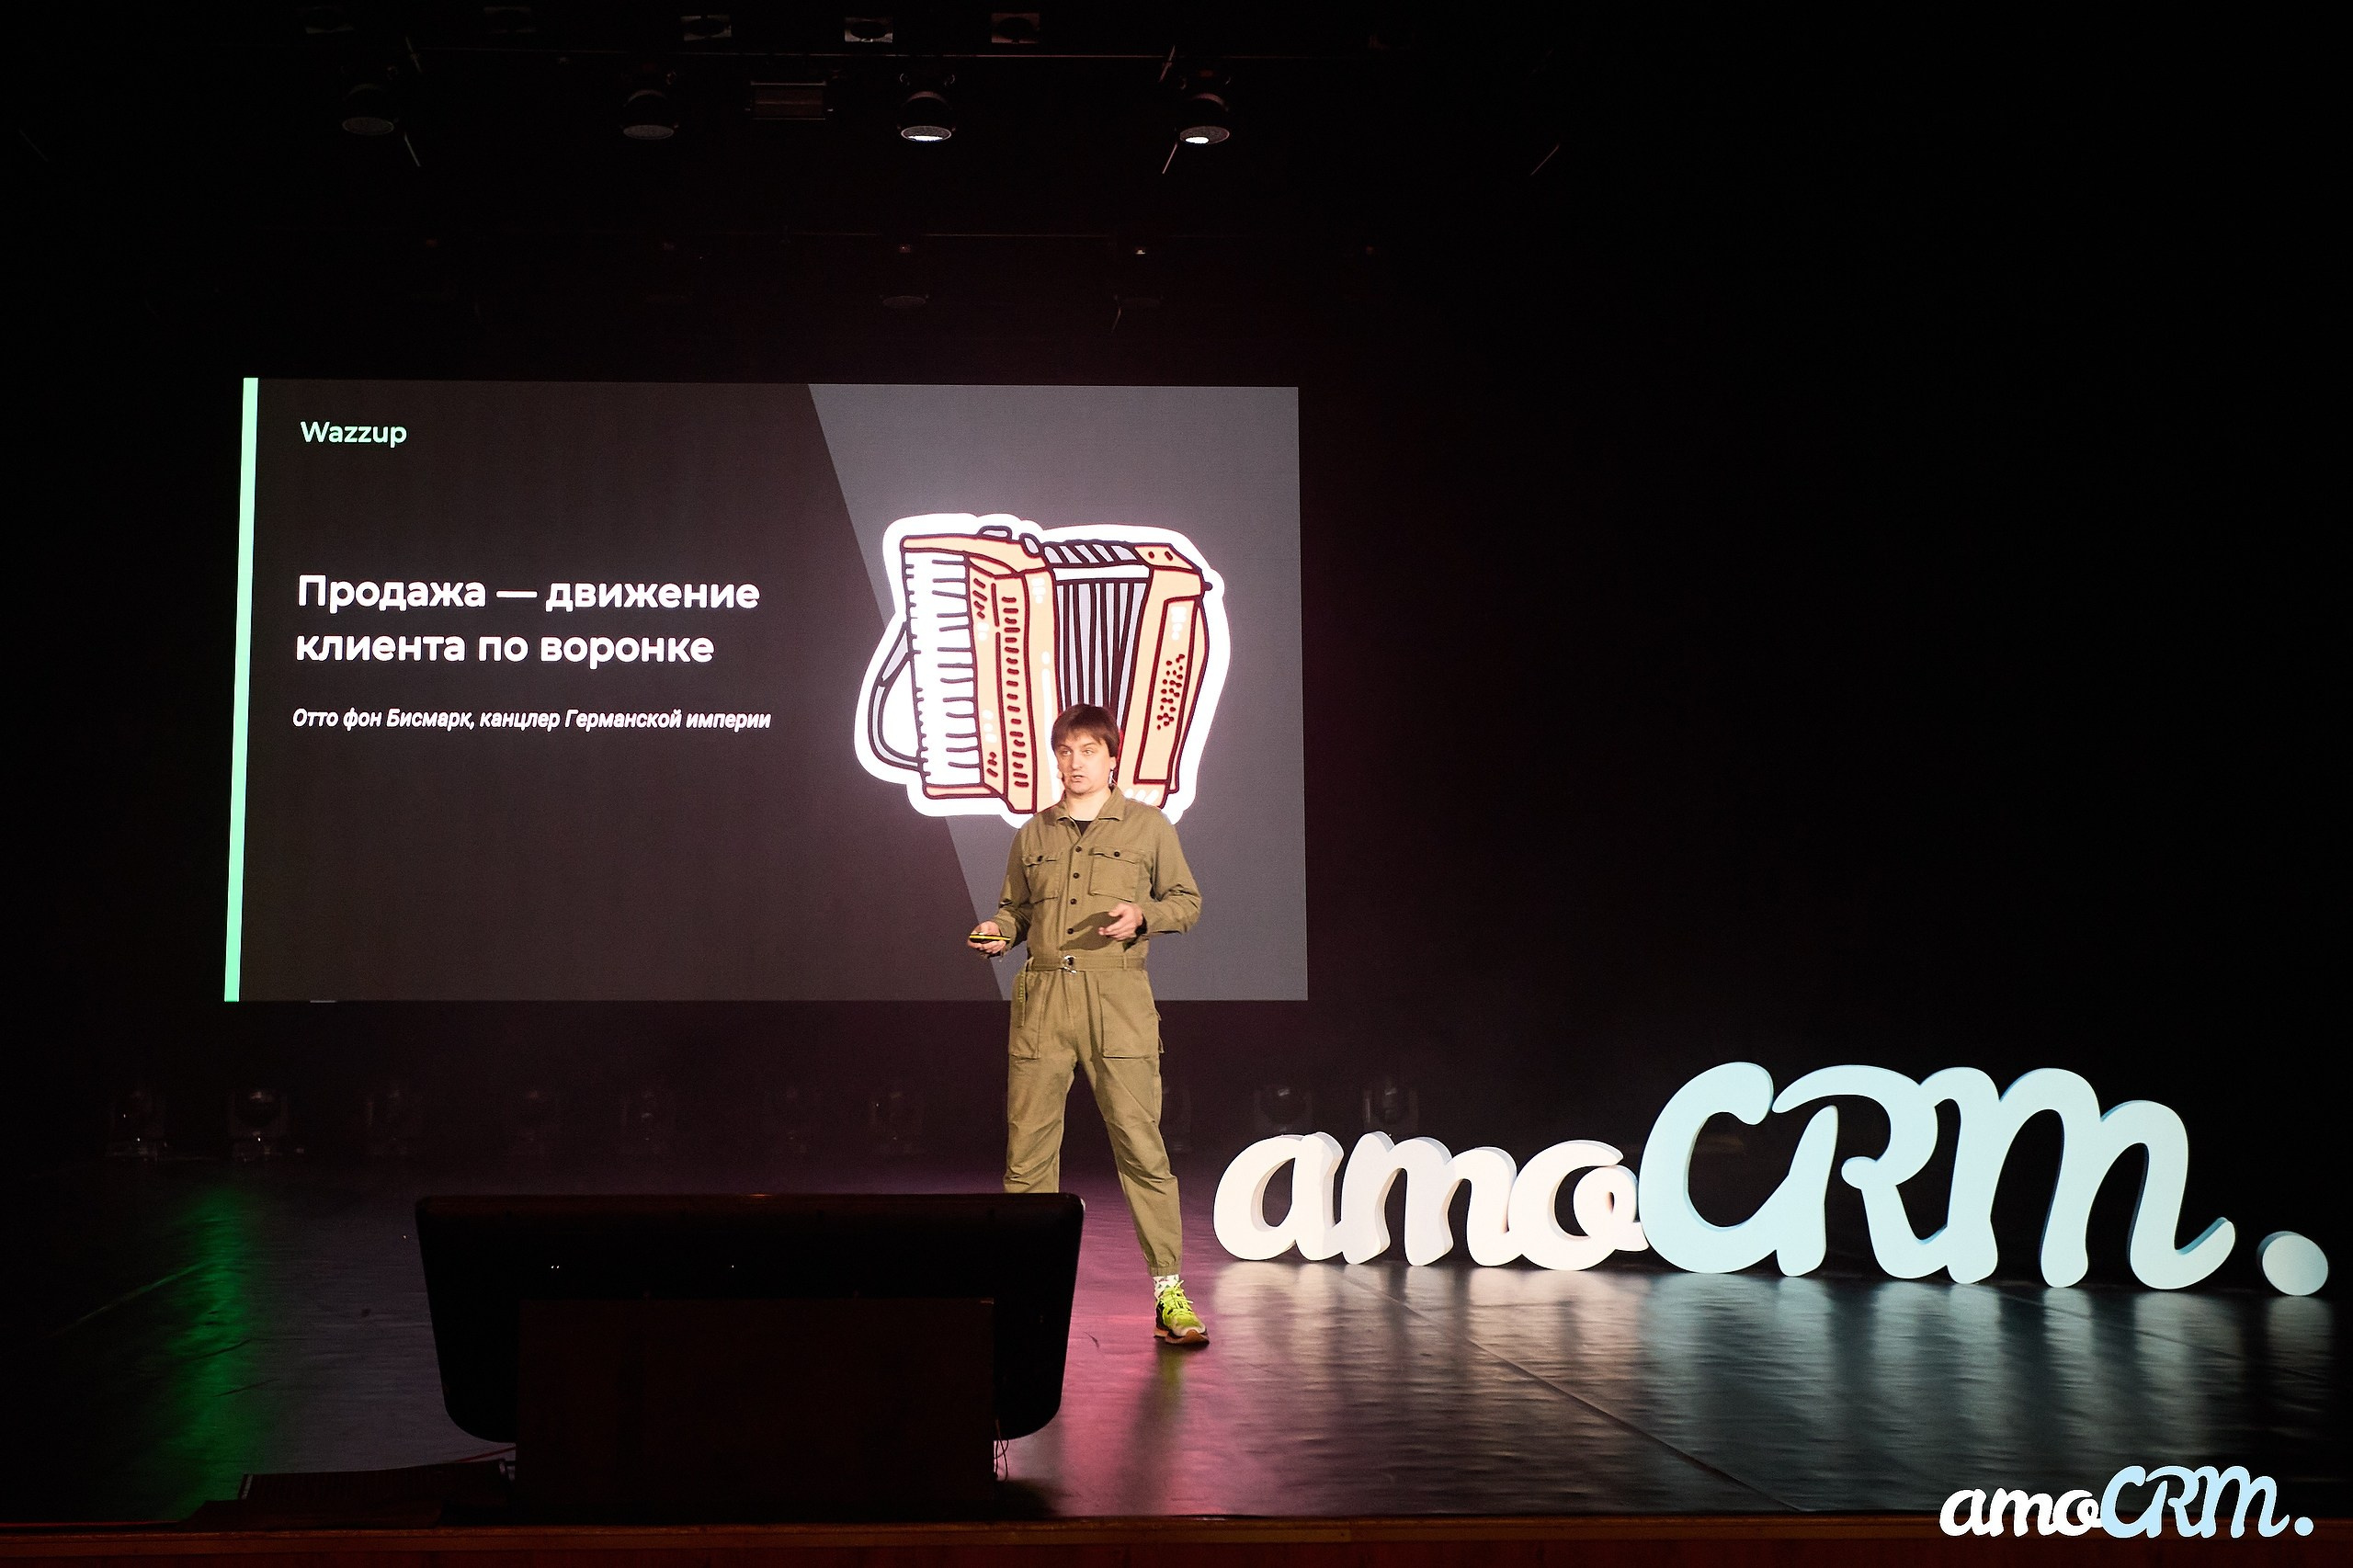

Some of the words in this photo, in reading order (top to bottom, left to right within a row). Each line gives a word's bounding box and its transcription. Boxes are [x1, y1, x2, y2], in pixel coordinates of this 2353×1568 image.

[301, 422, 407, 448] Wazzup
[298, 575, 486, 614] Продажа
[546, 583, 760, 612] движение
[296, 635, 466, 662] клиента
[478, 637, 529, 662] по
[540, 637, 715, 670] воронке
[292, 709, 339, 727] Отто
[343, 708, 382, 732] фон
[386, 709, 475, 733] Бисмарк,
[479, 712, 561, 733] канцлер
[564, 709, 682, 733] Германской
[685, 712, 771, 733] империи
